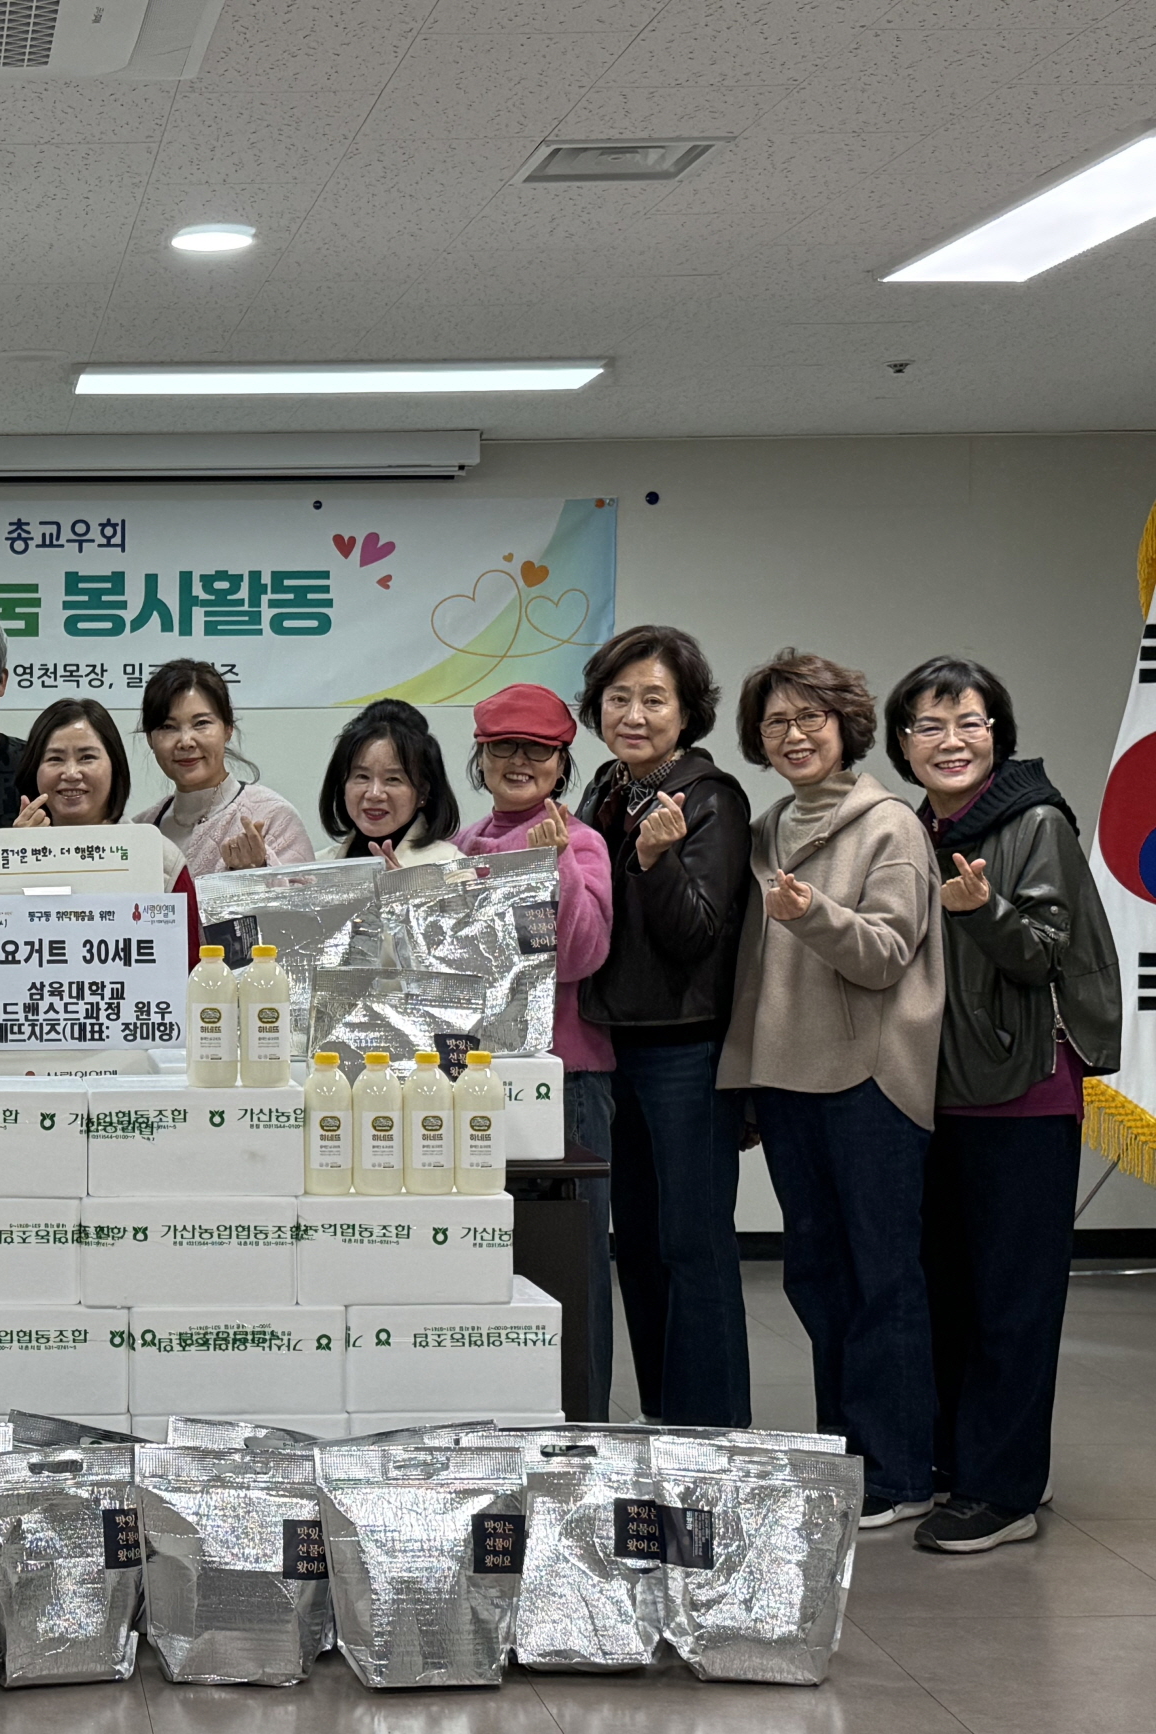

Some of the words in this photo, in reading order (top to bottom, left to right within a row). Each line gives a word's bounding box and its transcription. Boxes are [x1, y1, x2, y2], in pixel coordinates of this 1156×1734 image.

[4, 518, 127, 556] 총교우회
[62, 570, 334, 637] 봉사활동
[12, 662, 114, 690] 영천목장,
[1, 847, 28, 869] 즐거운
[60, 847, 71, 855] 더
[74, 845, 106, 861] 행복한
[109, 845, 129, 861] 나눔
[0, 938, 69, 968] 요거트
[82, 937, 157, 967] 30세트
[27, 981, 126, 1001] 삼육대학교
[134, 1001, 173, 1021] 원우
[120, 1021, 182, 1043] 장미향)
[319, 1133, 341, 1142] 하네뜨
[372, 1133, 394, 1142] 하네뜨
[421, 1133, 444, 1142] 하네뜨
[469, 1133, 492, 1142] 하네뜨
[412, 1332, 558, 1348] 가산농업협동조합
[115, 1515, 138, 1527] 맛있
[484, 1520, 514, 1534] 맛있는
[297, 1526, 323, 1540] 맛있
[484, 1537, 512, 1551] 선물이
[484, 1554, 511, 1567] 왔어요
